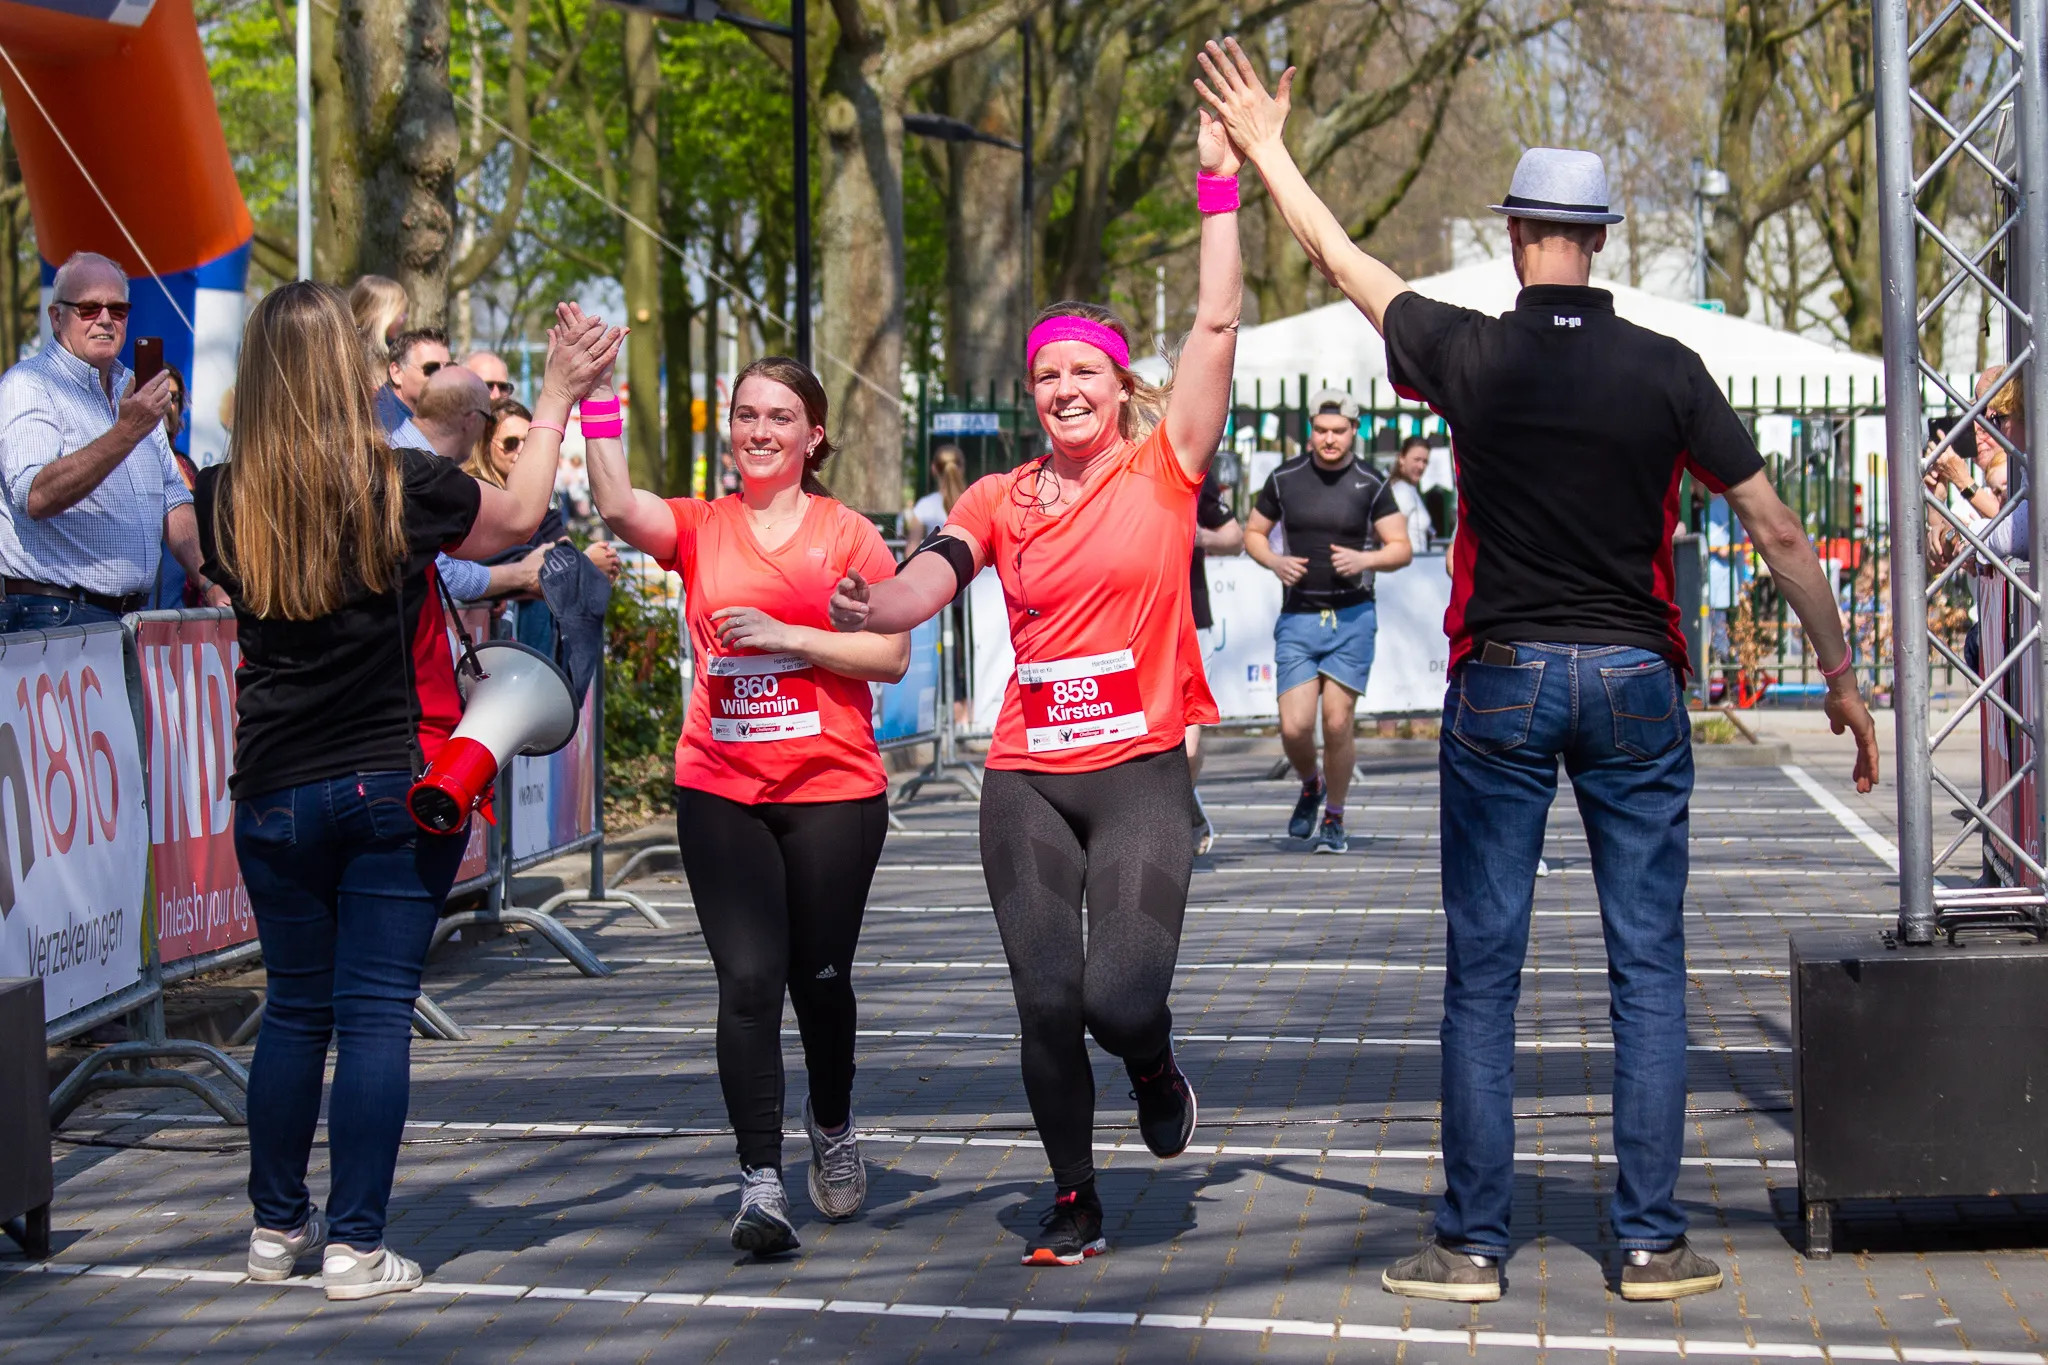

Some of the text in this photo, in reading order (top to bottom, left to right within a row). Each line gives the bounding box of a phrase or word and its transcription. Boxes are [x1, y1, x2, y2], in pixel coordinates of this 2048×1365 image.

[733, 675, 779, 698] 860
[1052, 677, 1099, 704] 859
[720, 696, 799, 715] Willemijn
[1046, 701, 1114, 722] Kirsten
[205, 887, 232, 942] your
[27, 906, 124, 977] Verzekeringen
